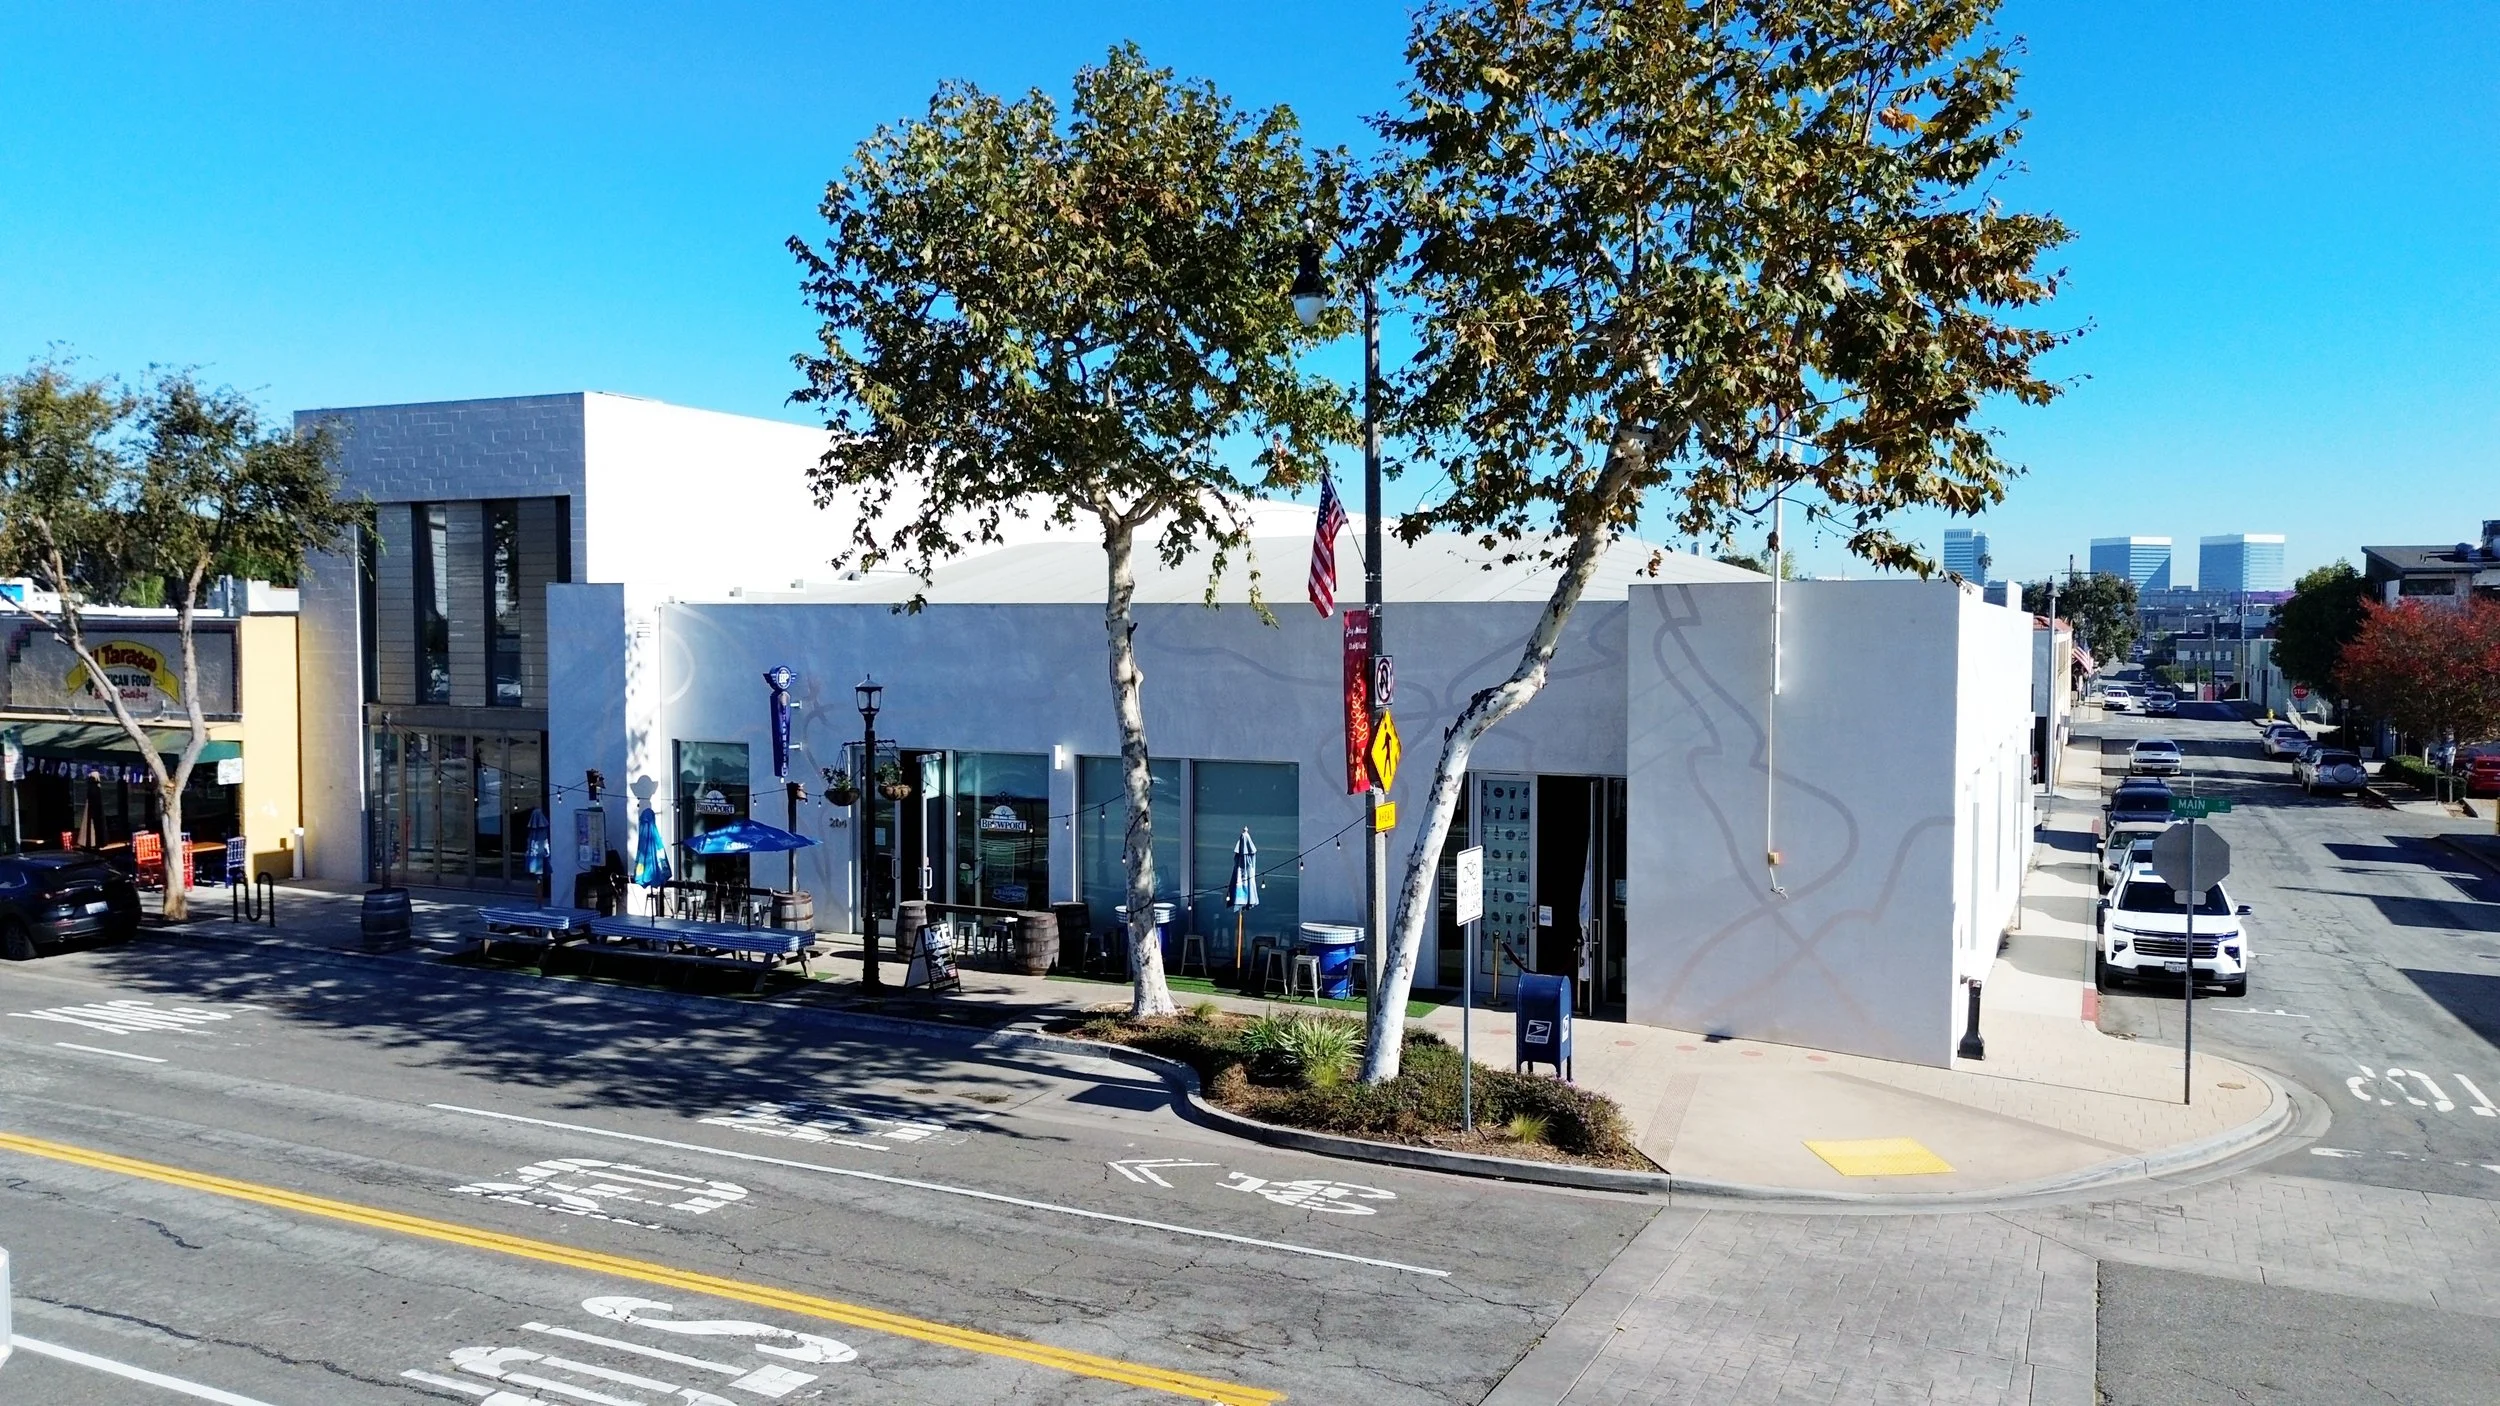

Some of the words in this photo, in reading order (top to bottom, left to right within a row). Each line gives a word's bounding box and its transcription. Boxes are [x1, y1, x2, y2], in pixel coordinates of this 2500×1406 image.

[131, 674, 151, 686] FOOD
[2178, 799, 2206, 810] MAIN
[1379, 810, 1393, 822] AHEAD
[924, 923, 951, 945] AXE
[2346, 1065, 2500, 1117] TOP
